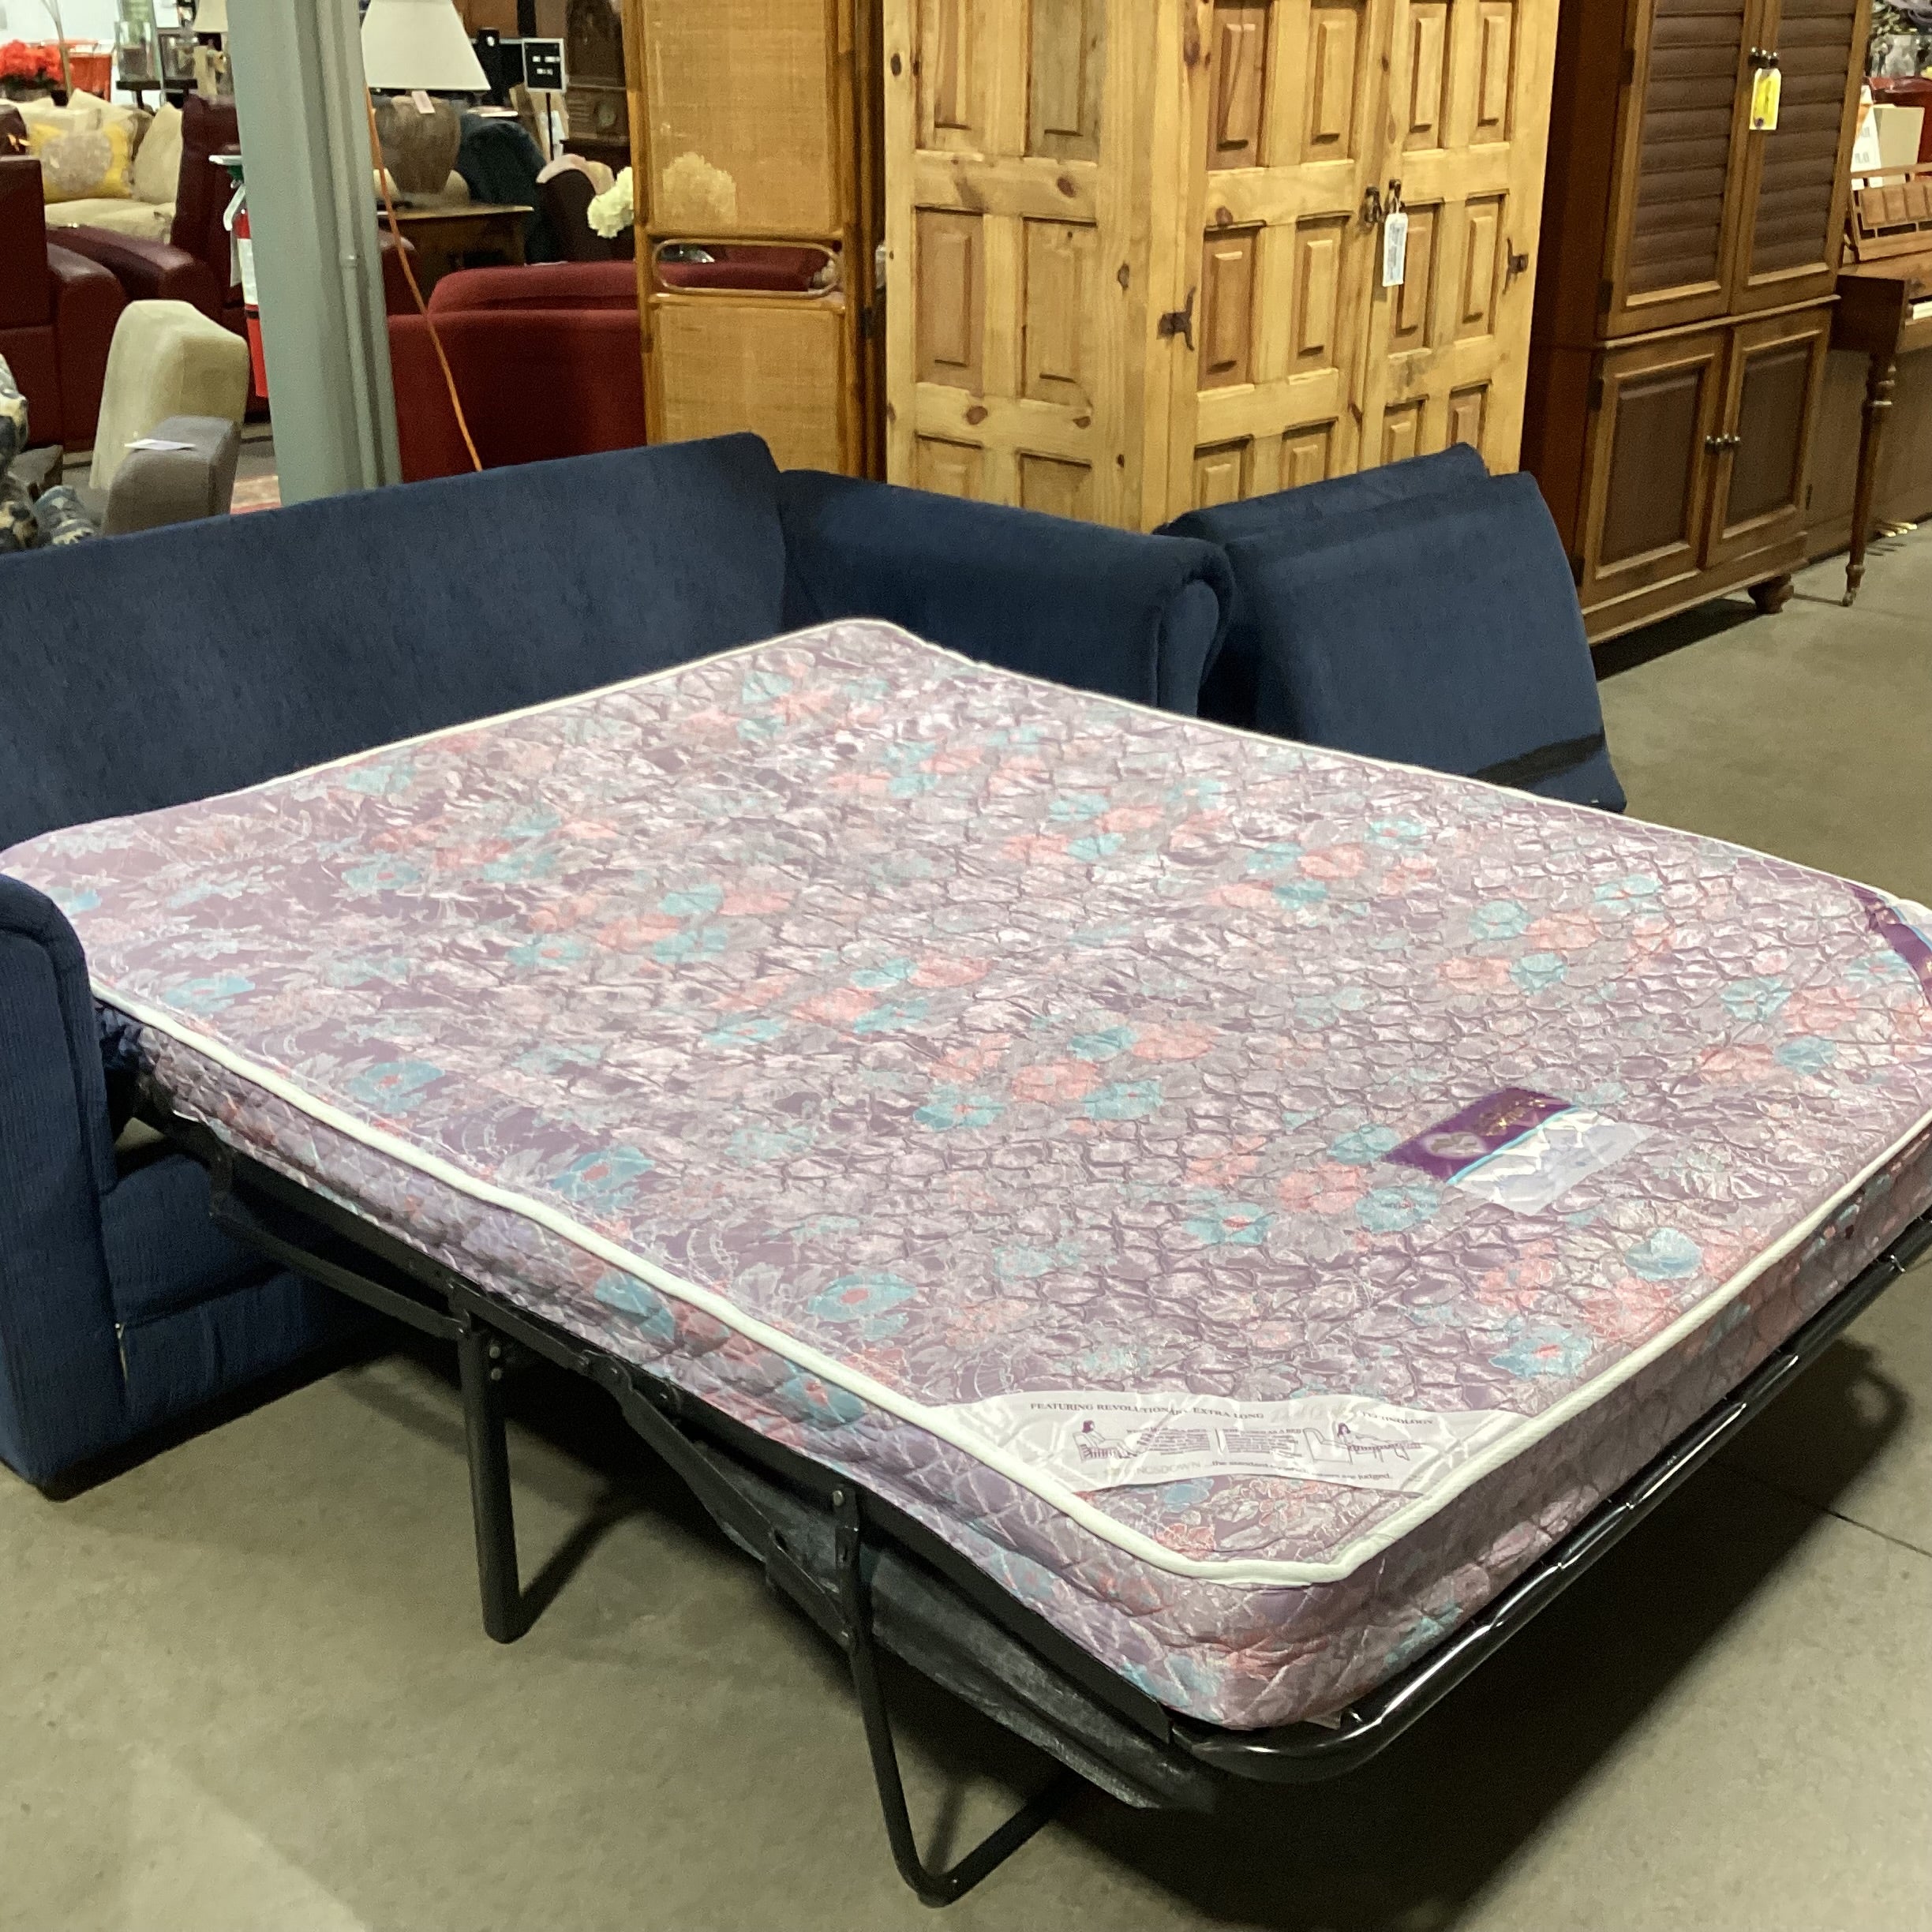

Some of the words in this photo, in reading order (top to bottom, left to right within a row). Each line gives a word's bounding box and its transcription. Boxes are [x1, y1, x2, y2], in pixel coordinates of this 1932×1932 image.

[1030, 1402, 1094, 1411] FEATURING
[1193, 1407, 1231, 1418] EXTRA
[1129, 1461, 1201, 1475] NGSDOWN
